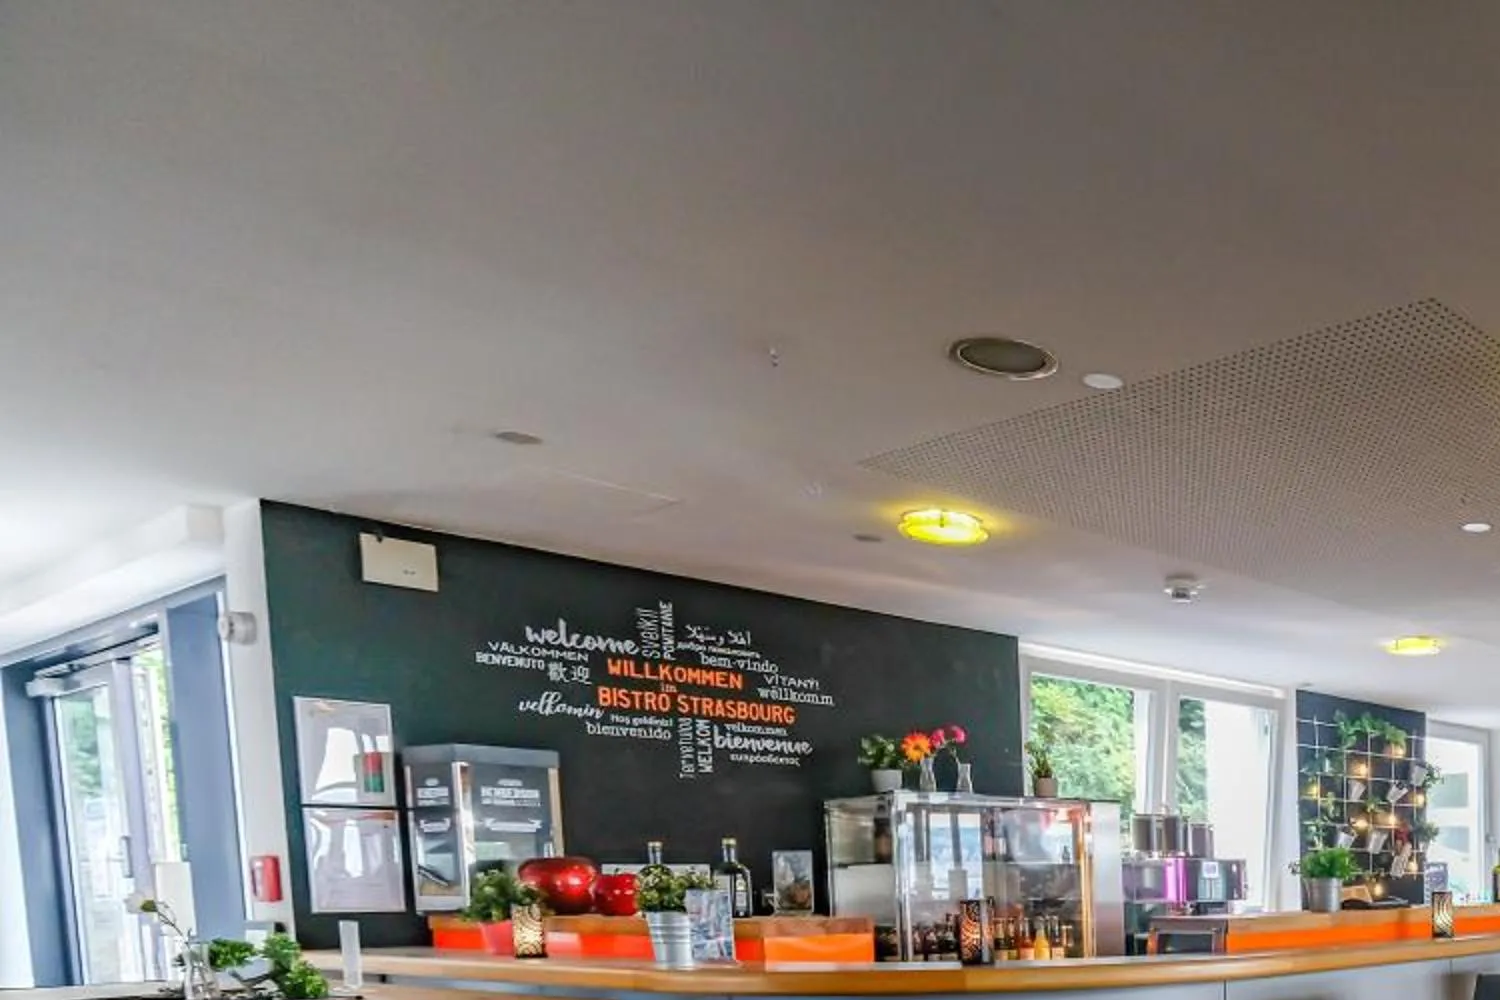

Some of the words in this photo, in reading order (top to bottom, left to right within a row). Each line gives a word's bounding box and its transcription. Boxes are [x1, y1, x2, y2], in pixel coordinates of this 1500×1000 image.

[524, 617, 640, 655] welcome
[475, 652, 544, 670] BENVENUTO
[606, 658, 743, 690] WILLKOMMEN
[701, 652, 778, 673] bem-vindo
[660, 682, 677, 693] im
[597, 685, 671, 713] BISTRO
[677, 695, 796, 725] STRASBOURG
[585, 721, 672, 740] bienvenido
[695, 718, 714, 773] WELKOM
[713, 724, 813, 755] bienvenue
